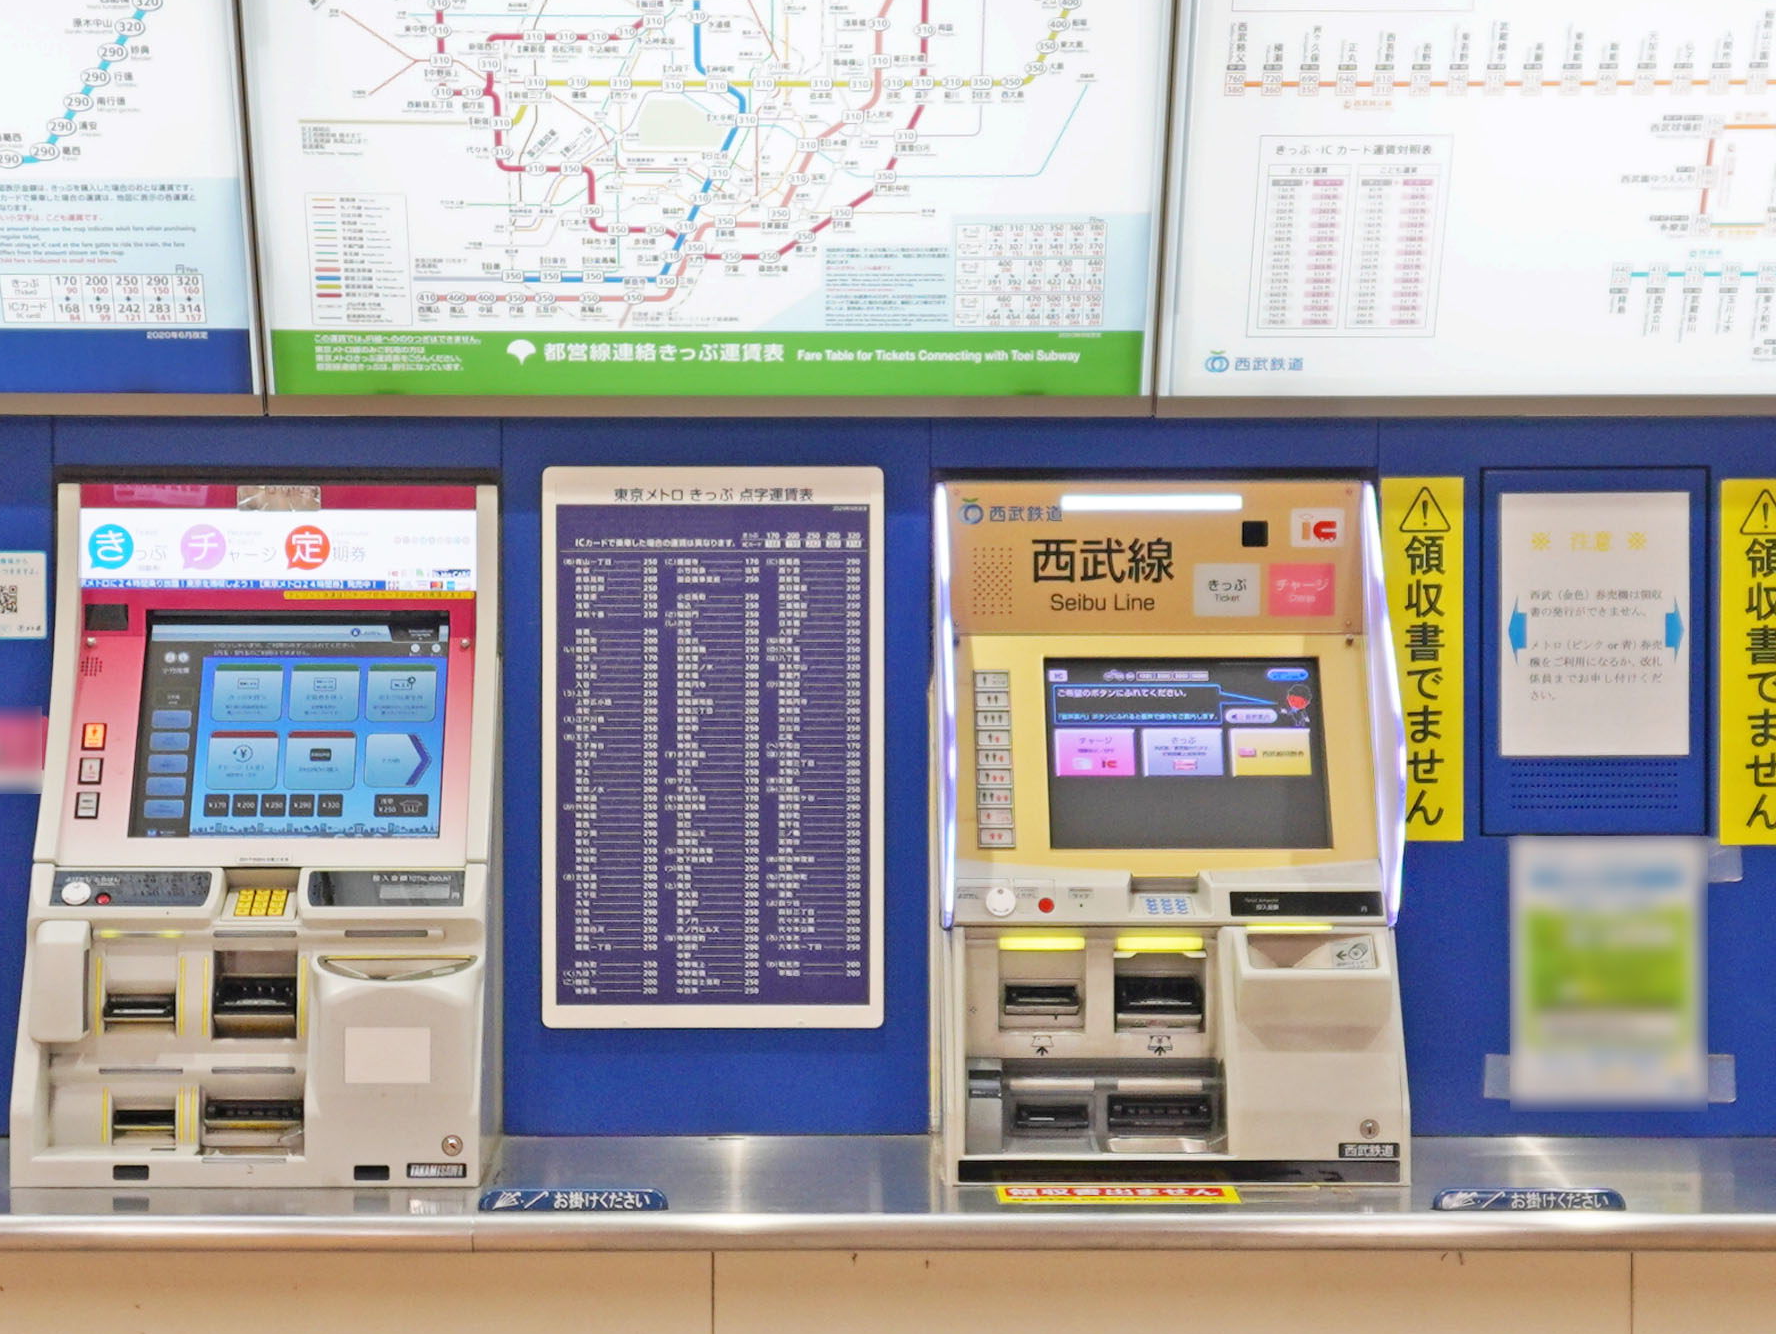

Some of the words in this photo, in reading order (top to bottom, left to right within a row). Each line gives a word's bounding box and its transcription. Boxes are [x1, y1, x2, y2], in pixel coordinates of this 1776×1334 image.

[118, 22, 141, 32] 320
[526, 32, 543, 41] 310
[101, 48, 123, 57] 290
[84, 73, 106, 82] 290
[1228, 75, 1244, 83] 760
[1265, 75, 1281, 83] 720
[1302, 75, 1317, 83] 690
[55, 277, 77, 286] 170
[85, 277, 107, 286] 200
[116, 277, 138, 286] 250
[147, 277, 168, 286] 290
[177, 277, 199, 286] 320
[8, 303, 46, 311] ICカード
[59, 304, 79, 312] 168
[89, 304, 110, 312] 199
[118, 304, 140, 312] 242
[148, 304, 170, 312] 283
[179, 304, 201, 312] 314
[544, 343, 784, 362] 都営線連絡きっぷ運賃表
[797, 350, 822, 361] Fare
[825, 350, 854, 361] Table
[857, 350, 872, 361] for
[875, 350, 916, 361] Tickets
[918, 350, 982, 363] Connecting
[985, 350, 1009, 361] with
[1012, 350, 1034, 361] Toei
[1037, 350, 1080, 363] Subway
[1234, 357, 1304, 371] 西武鉄道
[614, 488, 683, 502] 東京メトロ
[689, 489, 733, 501] きっぷ
[739, 488, 814, 502] 点字運賃表
[990, 506, 1063, 522] 西武鉄道
[1570, 531, 1613, 553] 注意
[1031, 538, 1175, 584] 西武線
[1208, 578, 1247, 592] きっぷ
[1276, 579, 1329, 592] チャージ
[1215, 593, 1240, 603] Ticket
[1529, 589, 1662, 601] 西武（金色）券売機は領収
[1051, 594, 1108, 612] Seibu
[1114, 594, 1155, 611] Line
[1530, 605, 1647, 618] 書の発行ができません。
[1529, 655, 1662, 668] 機をご利用になるか、改札
[1404, 535, 1446, 827] 領収書でません
[1529, 673, 1662, 685] 係員までお申し付けくだ
[1057, 688, 1188, 698] ご希望のボタンにふれてください。
[1530, 690, 1557, 701] さい。
[1079, 736, 1113, 744] チャージ
[1171, 736, 1196, 744] きっぷ
[237, 801, 255, 810] ¥200
[1343, 1144, 1395, 1158] 西武鉄道
[410, 1165, 464, 1177] TAKAMISAWA
[1005, 1187, 1220, 1199] 領収書出ません
[553, 1192, 650, 1209] お掛けください
[1510, 1192, 1610, 1210] お掛けください
